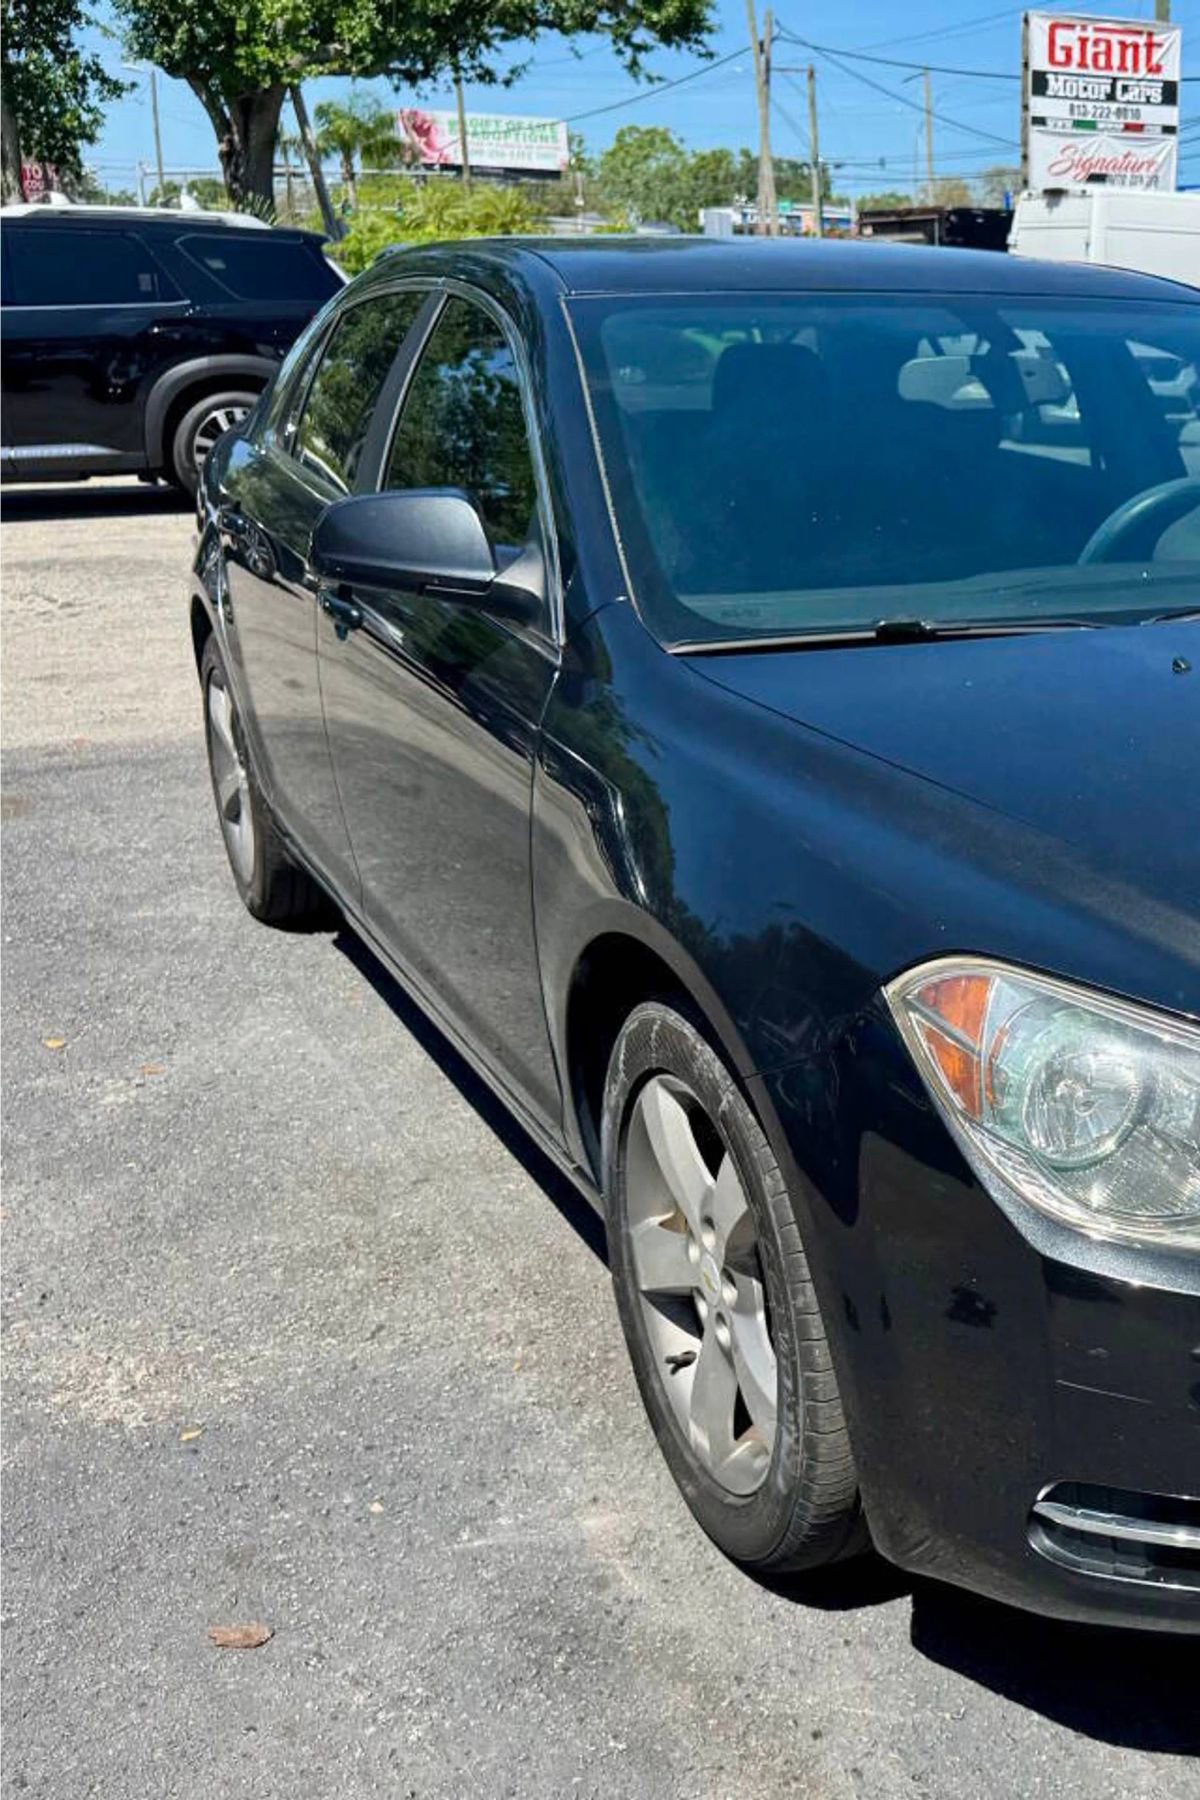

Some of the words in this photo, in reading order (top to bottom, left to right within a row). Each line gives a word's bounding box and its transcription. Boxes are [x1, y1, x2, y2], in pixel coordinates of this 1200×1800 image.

[1048, 21, 1163, 75] Giant
[1045, 73, 1112, 100] Motor
[1116, 80, 1164, 104] Cars
